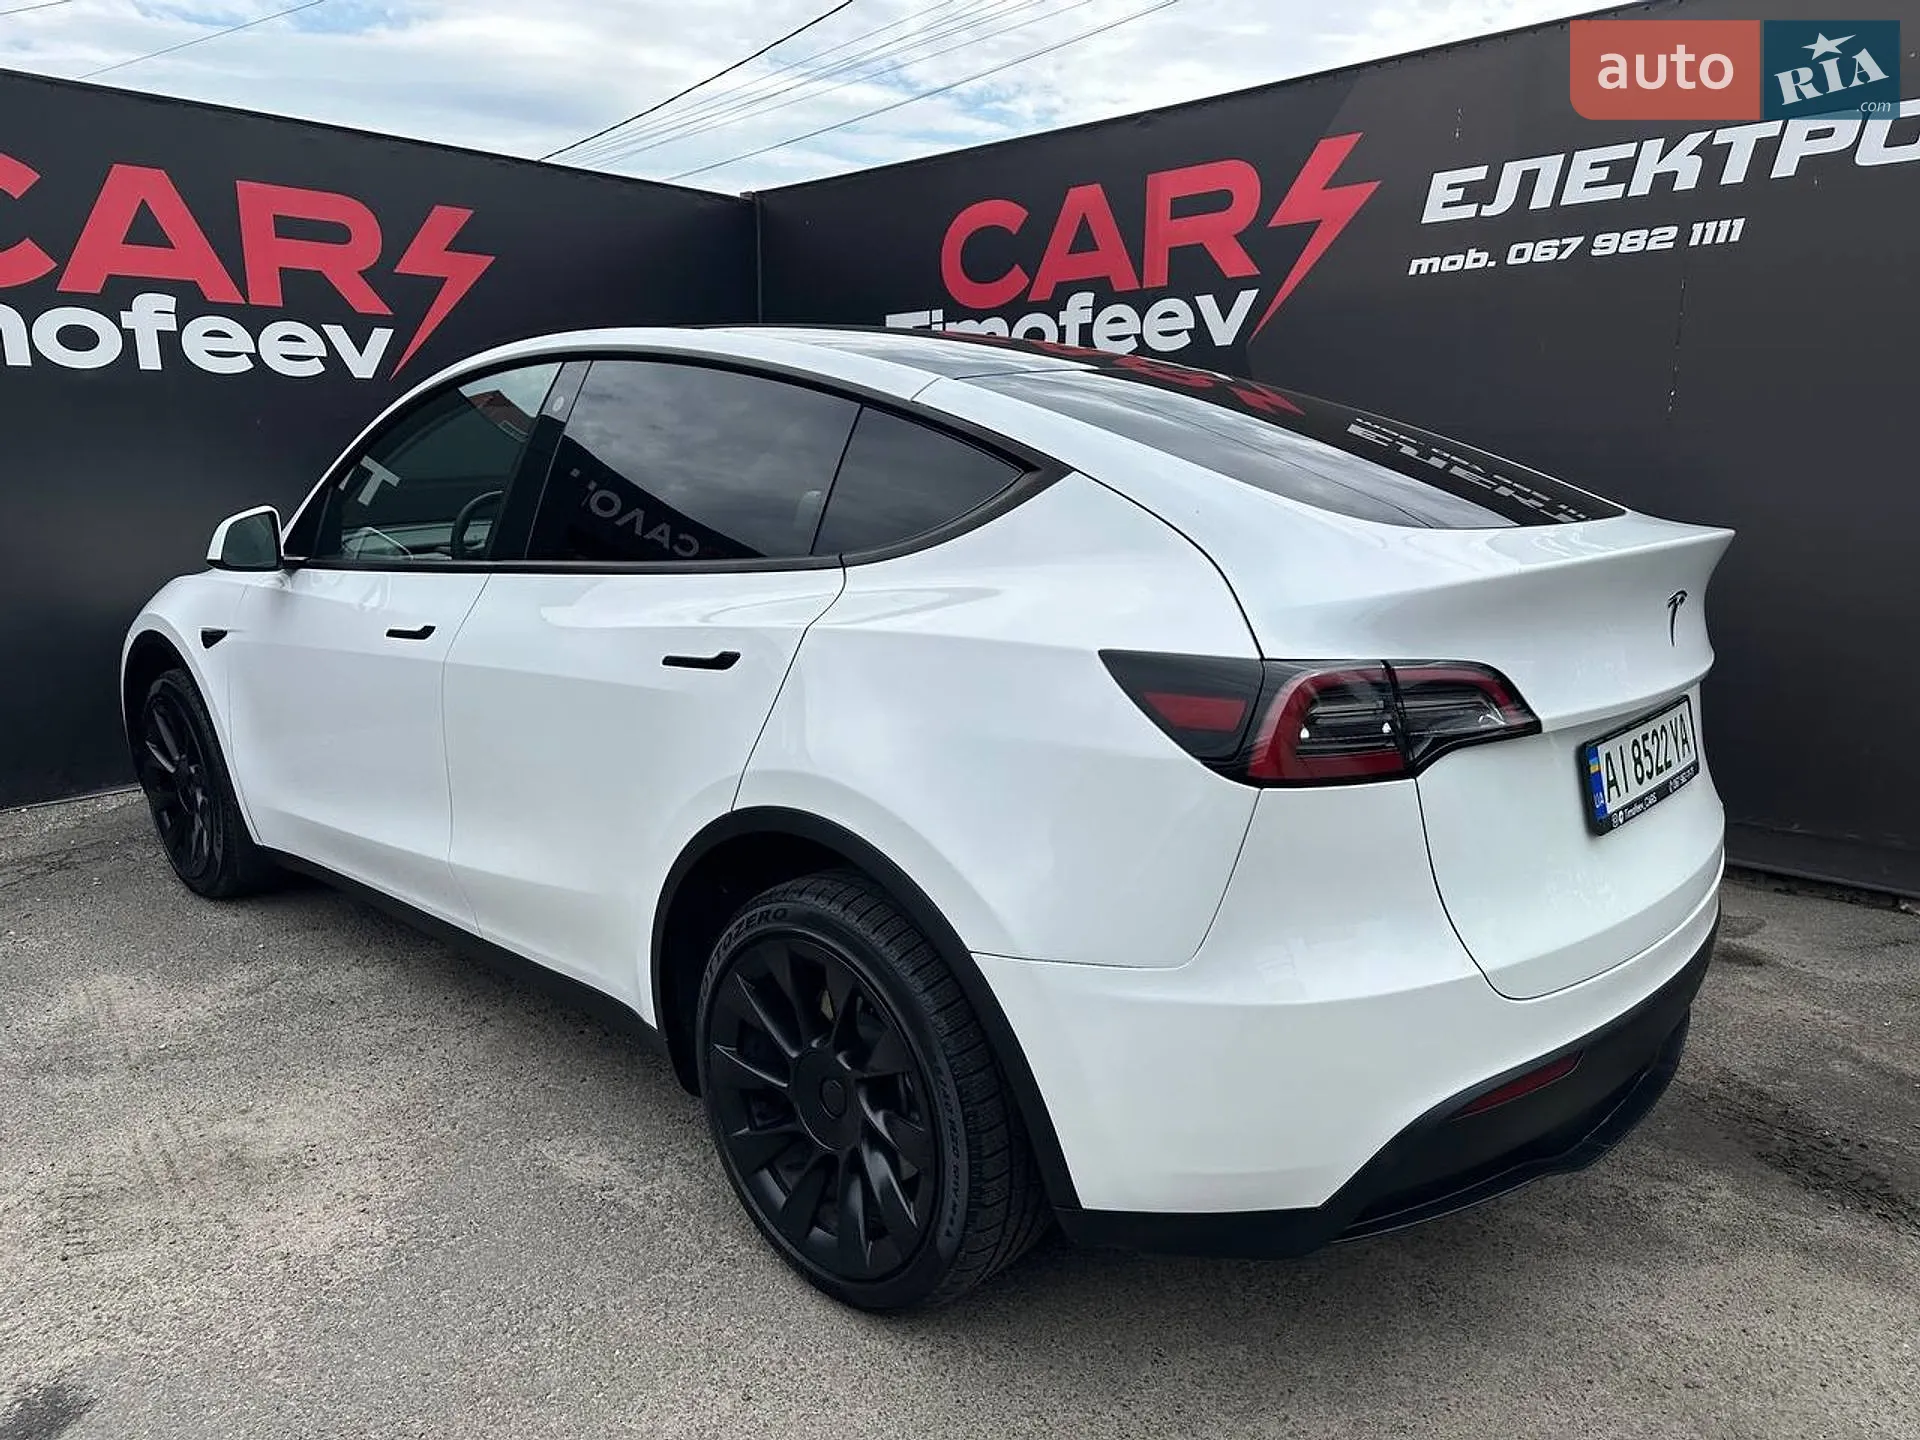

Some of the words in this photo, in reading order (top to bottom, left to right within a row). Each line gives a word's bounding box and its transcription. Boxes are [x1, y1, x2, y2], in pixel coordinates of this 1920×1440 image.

[1408, 246, 1496, 276] mob.
[1506, 236, 1585, 266] 067
[1590, 226, 1676, 257] 982
[1687, 217, 1747, 247] 1111
[1604, 744, 1629, 803] AI
[1631, 725, 1673, 786] 8522
[1669, 713, 1692, 763] YA
